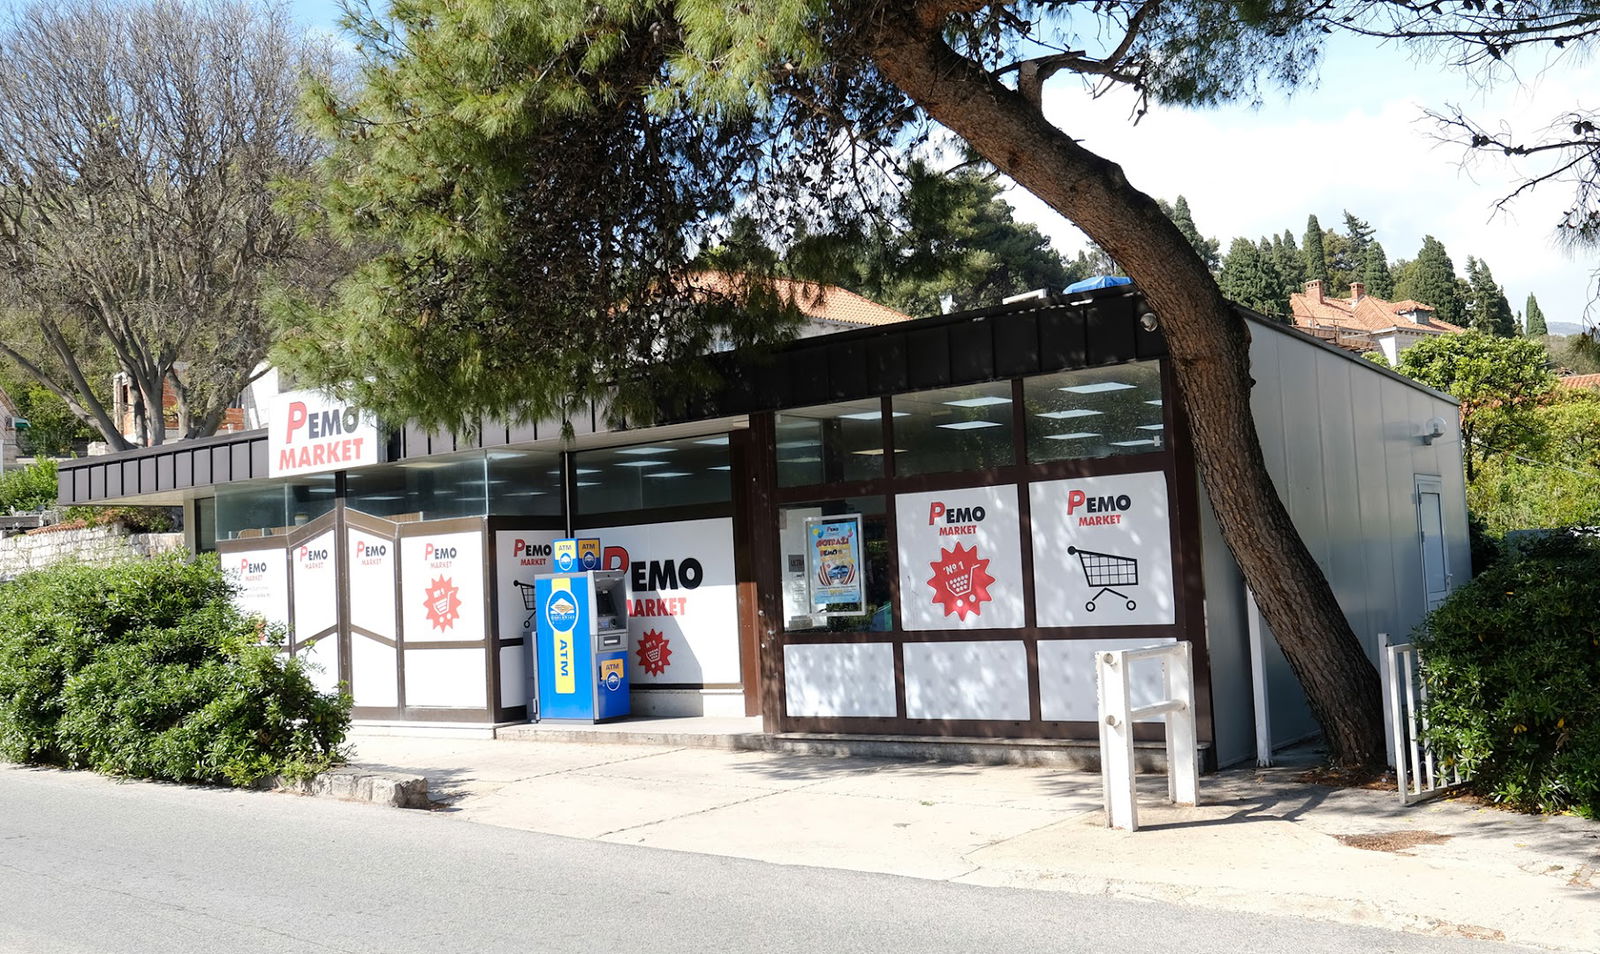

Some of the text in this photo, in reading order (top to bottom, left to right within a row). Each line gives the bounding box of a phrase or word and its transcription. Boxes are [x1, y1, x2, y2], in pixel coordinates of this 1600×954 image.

[285, 400, 360, 445] PEMO
[278, 437, 364, 471] MARKET
[1066, 490, 1132, 516] PEMO
[928, 502, 986, 526] PEMO
[1078, 514, 1122, 527] MARKET
[938, 525, 978, 536] MARKET
[299, 545, 328, 562] PEMO
[355, 540, 387, 559] PEMO
[424, 543, 457, 561] PEMO
[513, 538, 552, 558] PEMO
[581, 542, 596, 550] ATM
[240, 558, 267, 574] PEMO
[360, 557, 382, 566] MARKET
[431, 561, 453, 569] MARKET
[520, 558, 547, 567] MARKET
[602, 545, 703, 592] PEMO
[958, 561, 964, 570] 1
[559, 639, 569, 677] ATM
[605, 663, 620, 671] ATM
